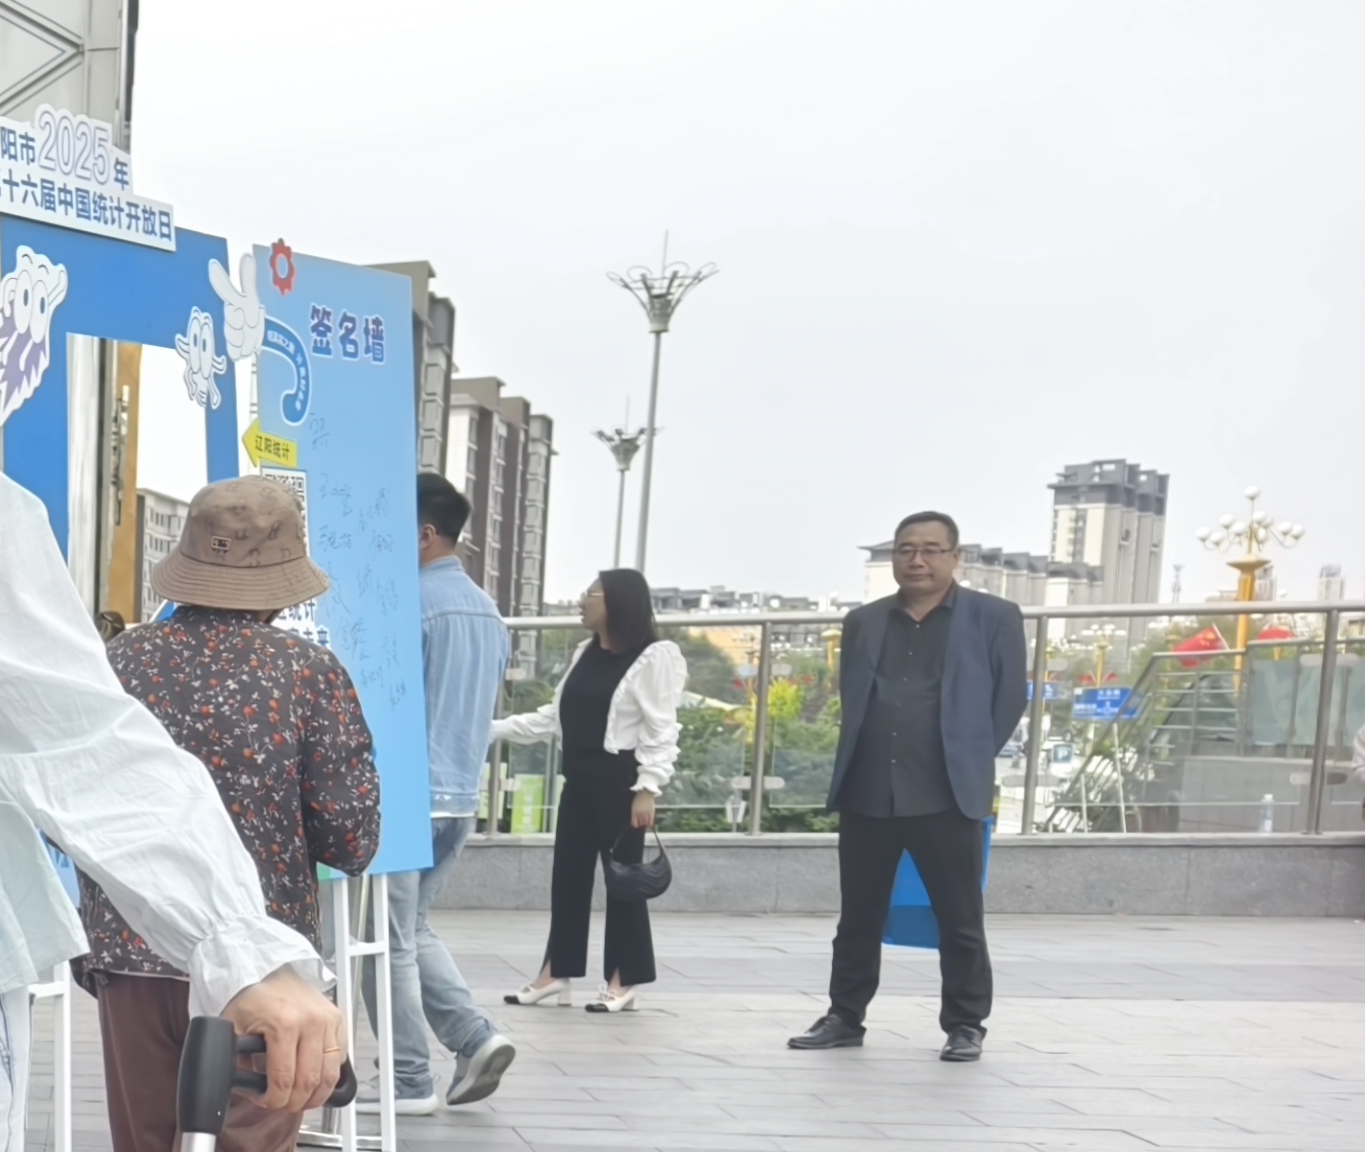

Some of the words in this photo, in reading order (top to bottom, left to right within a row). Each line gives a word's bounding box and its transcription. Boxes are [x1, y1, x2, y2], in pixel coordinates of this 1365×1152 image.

[309, 303, 386, 365] 签名墙
[254, 433, 291, 461] 辽阳统计
